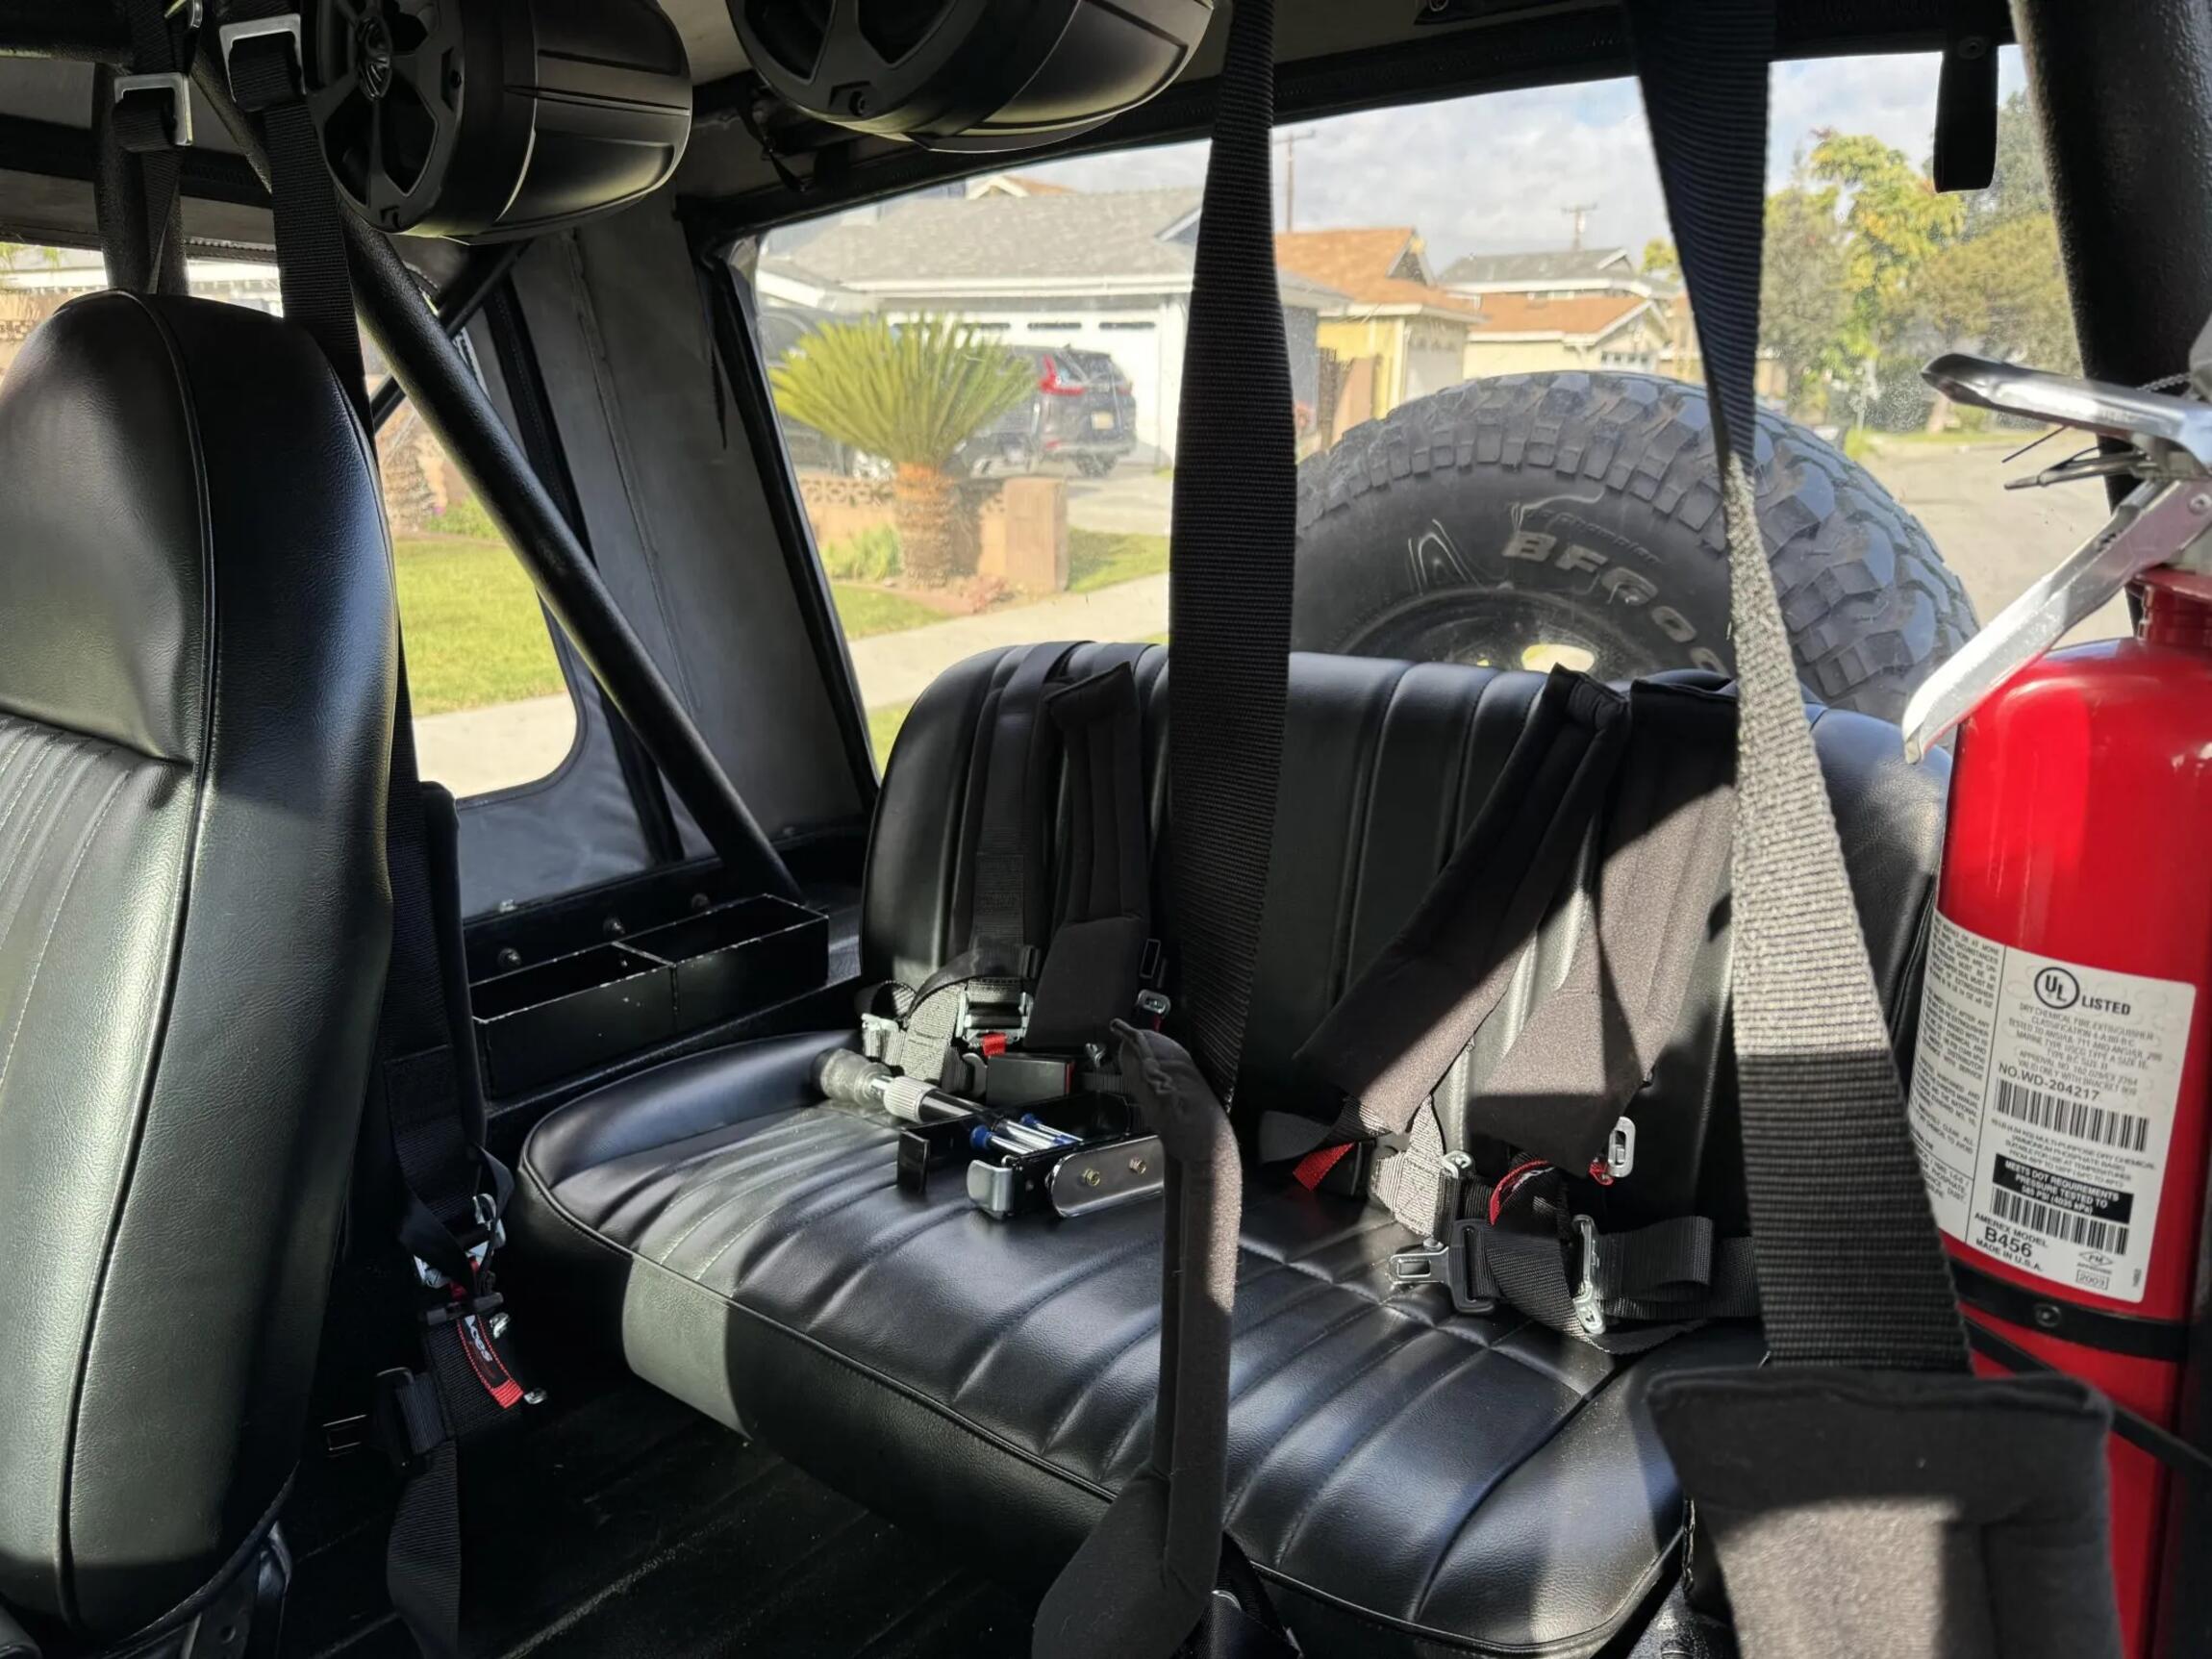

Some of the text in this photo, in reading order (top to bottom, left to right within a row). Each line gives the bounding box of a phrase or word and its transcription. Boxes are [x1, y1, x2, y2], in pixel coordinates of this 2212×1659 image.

[2081, 994, 2132, 1017] LISTED
[2003, 1159, 2030, 1176] MEETS
[2030, 1168, 2049, 1182] DOT
[2049, 1173, 2120, 1204] REQUIREMENTS
[2015, 1173, 2058, 1195] PRESSURE
[2058, 1187, 2094, 1206] TESTED
[2094, 1196, 2108, 1210] TO
[2035, 1190, 2049, 1202] PSI
[1975, 1212, 2047, 1248] AMEREX MODEL
[1984, 1226, 2032, 1258] B456
[1975, 1239, 2000, 1257] MADE
[2014, 1254, 2043, 1271] U.S.A.
